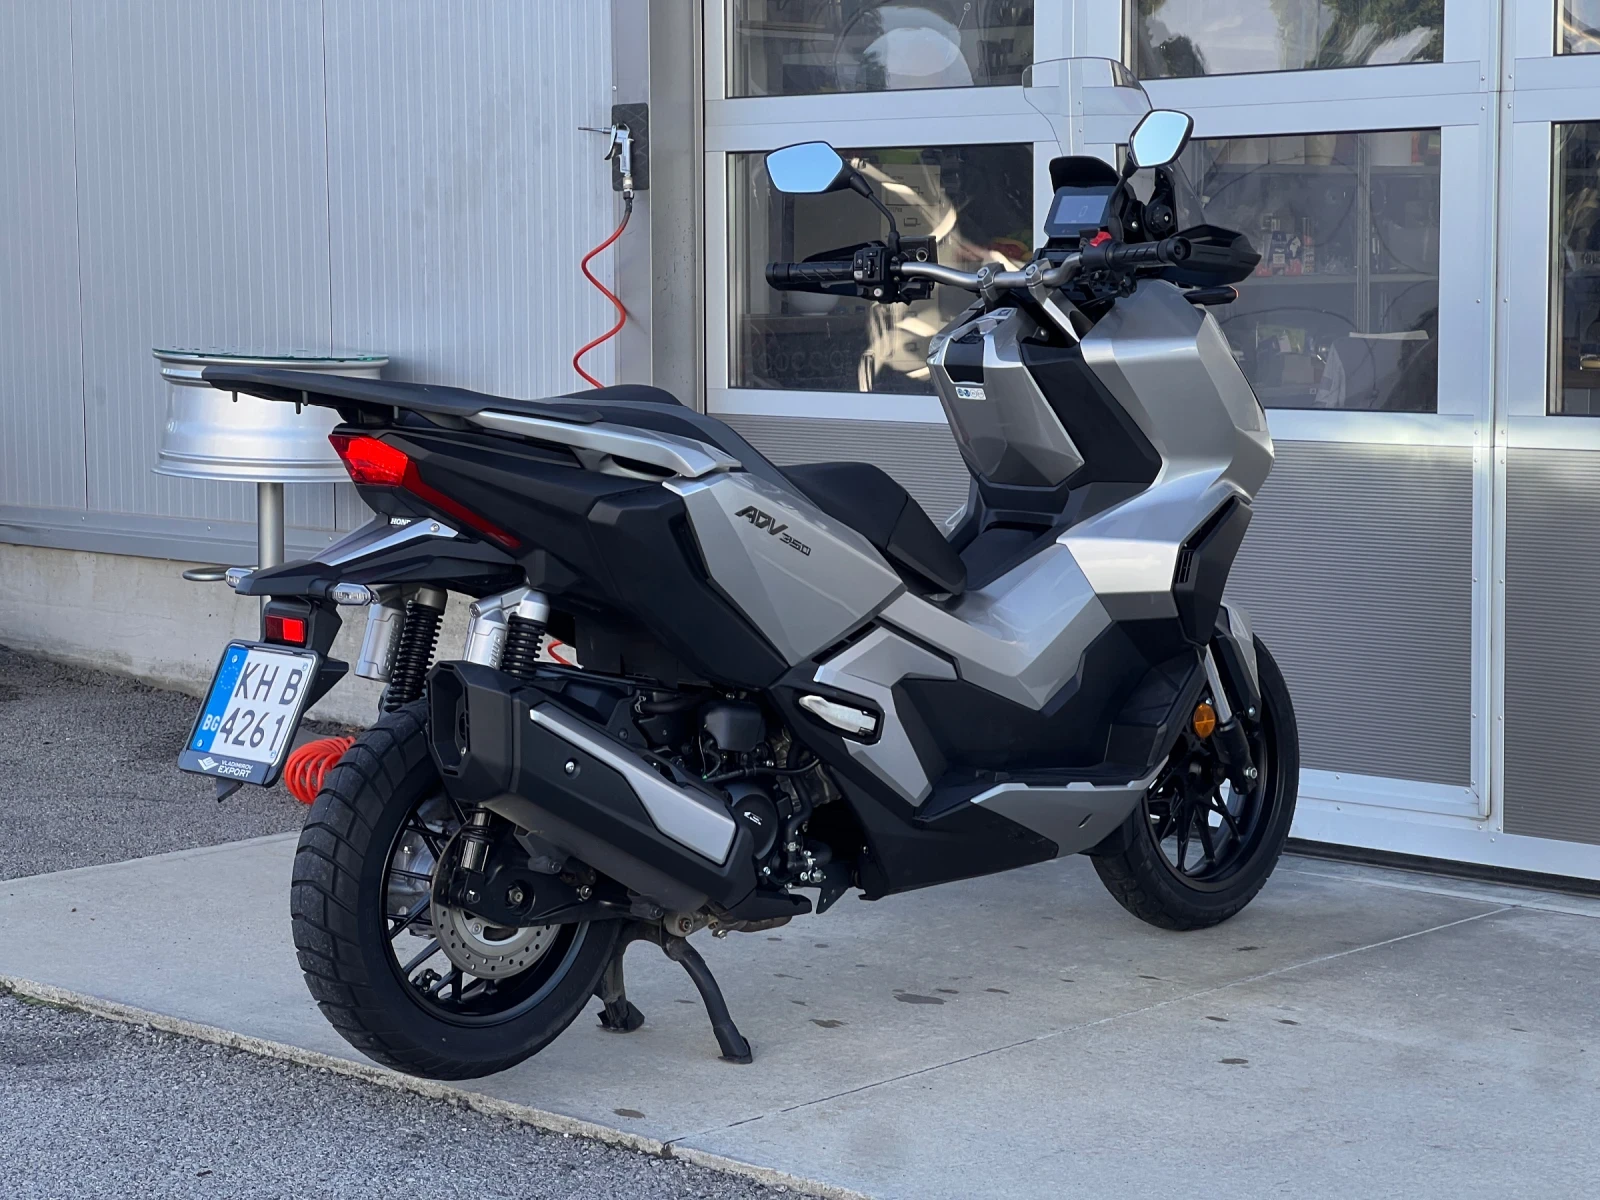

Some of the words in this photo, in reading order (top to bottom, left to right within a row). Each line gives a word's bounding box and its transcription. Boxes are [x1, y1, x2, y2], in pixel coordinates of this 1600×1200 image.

[734, 505, 789, 536] ADV
[234, 661, 280, 702] KH
[278, 668, 303, 706] B
[202, 713, 221, 732] BG
[219, 707, 286, 752] 4261
[217, 764, 252, 778] EXPORT
